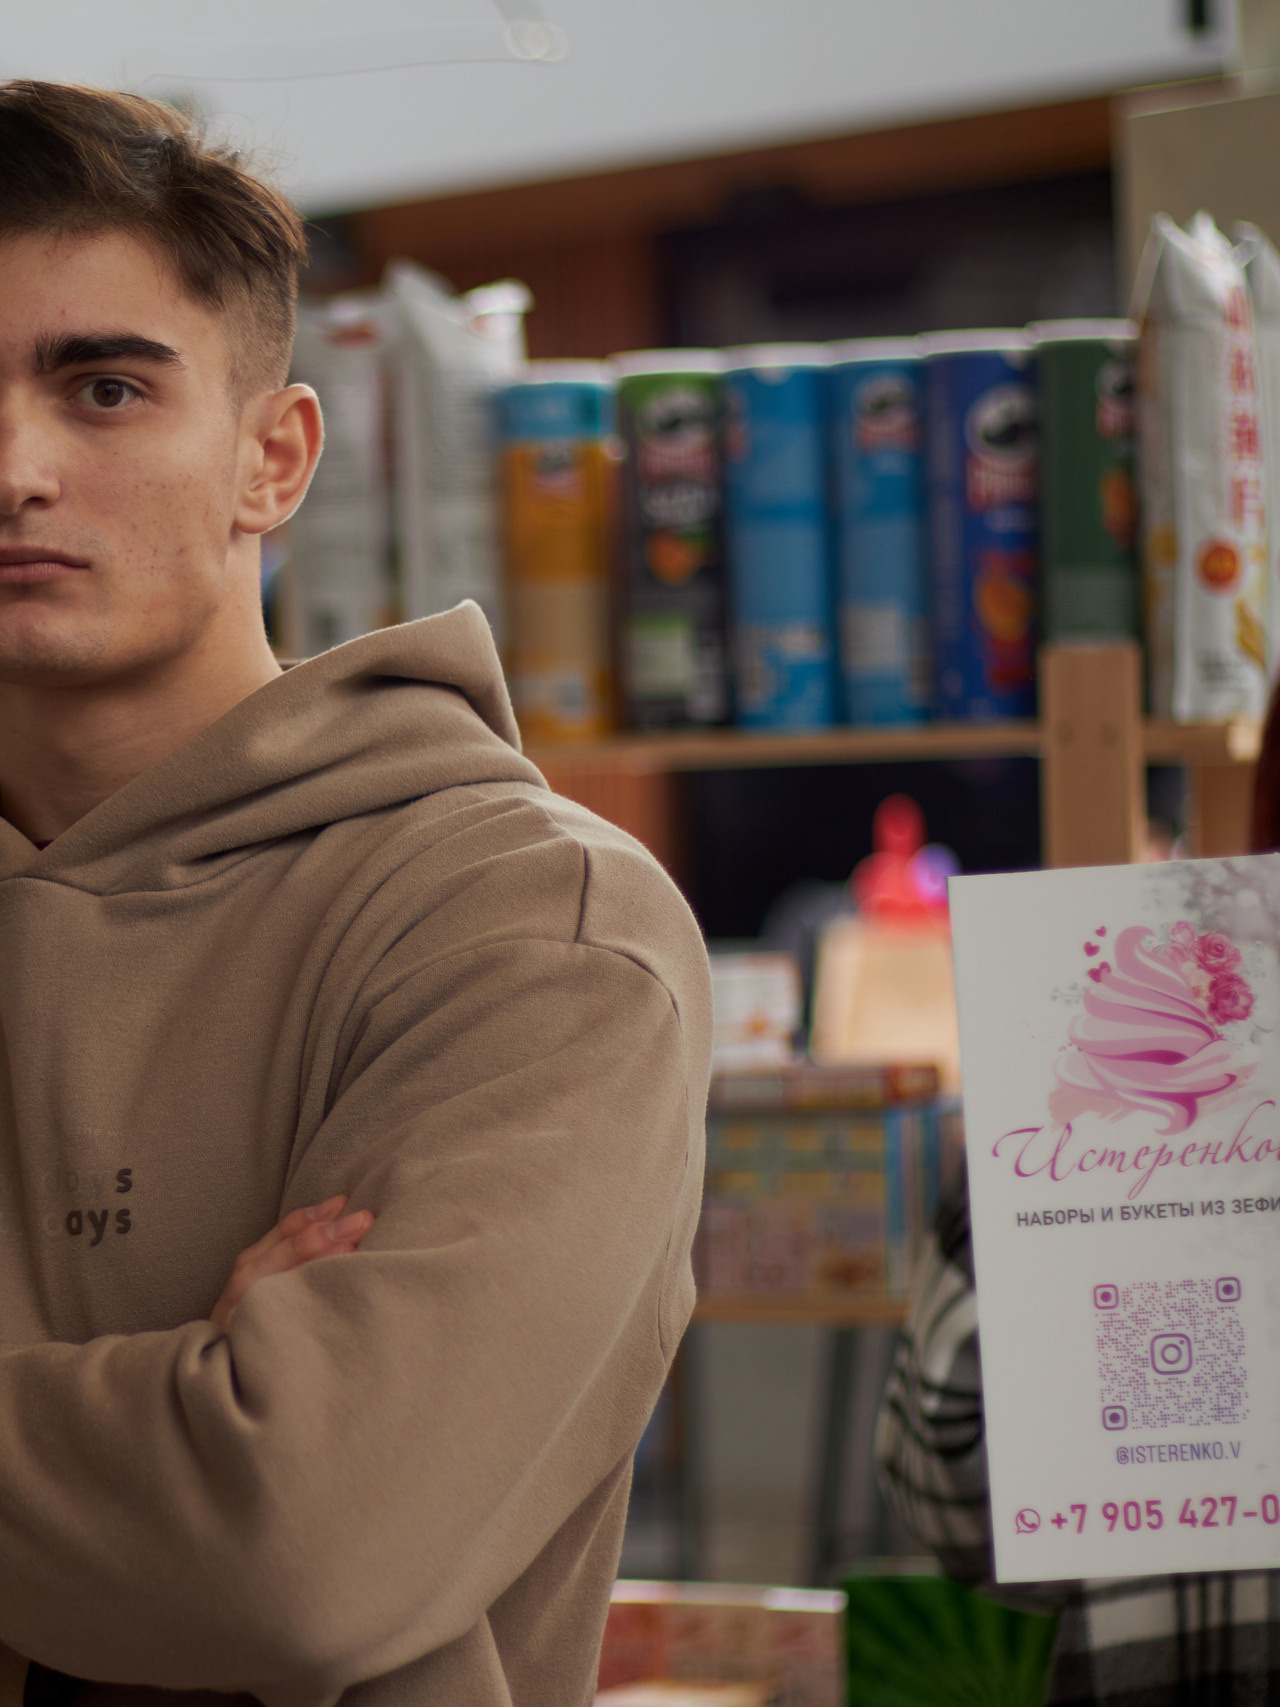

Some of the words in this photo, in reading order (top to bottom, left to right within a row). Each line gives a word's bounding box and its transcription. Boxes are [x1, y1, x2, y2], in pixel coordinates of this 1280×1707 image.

[992, 1100, 1280, 1200] Истеренко
[65, 1208, 133, 1246] ays
[1017, 1207, 1095, 1227] НАБОРЫ
[1102, 1206, 1114, 1222] И
[1120, 1201, 1195, 1221] БУКЕТЫ
[1201, 1199, 1226, 1216] ИЗ
[1115, 1440, 1242, 1465] @ISTERENKO.V
[1050, 1503, 1088, 1535] +7
[1101, 1499, 1165, 1533] 905
[1178, 1493, 1280, 1528] 427-0
